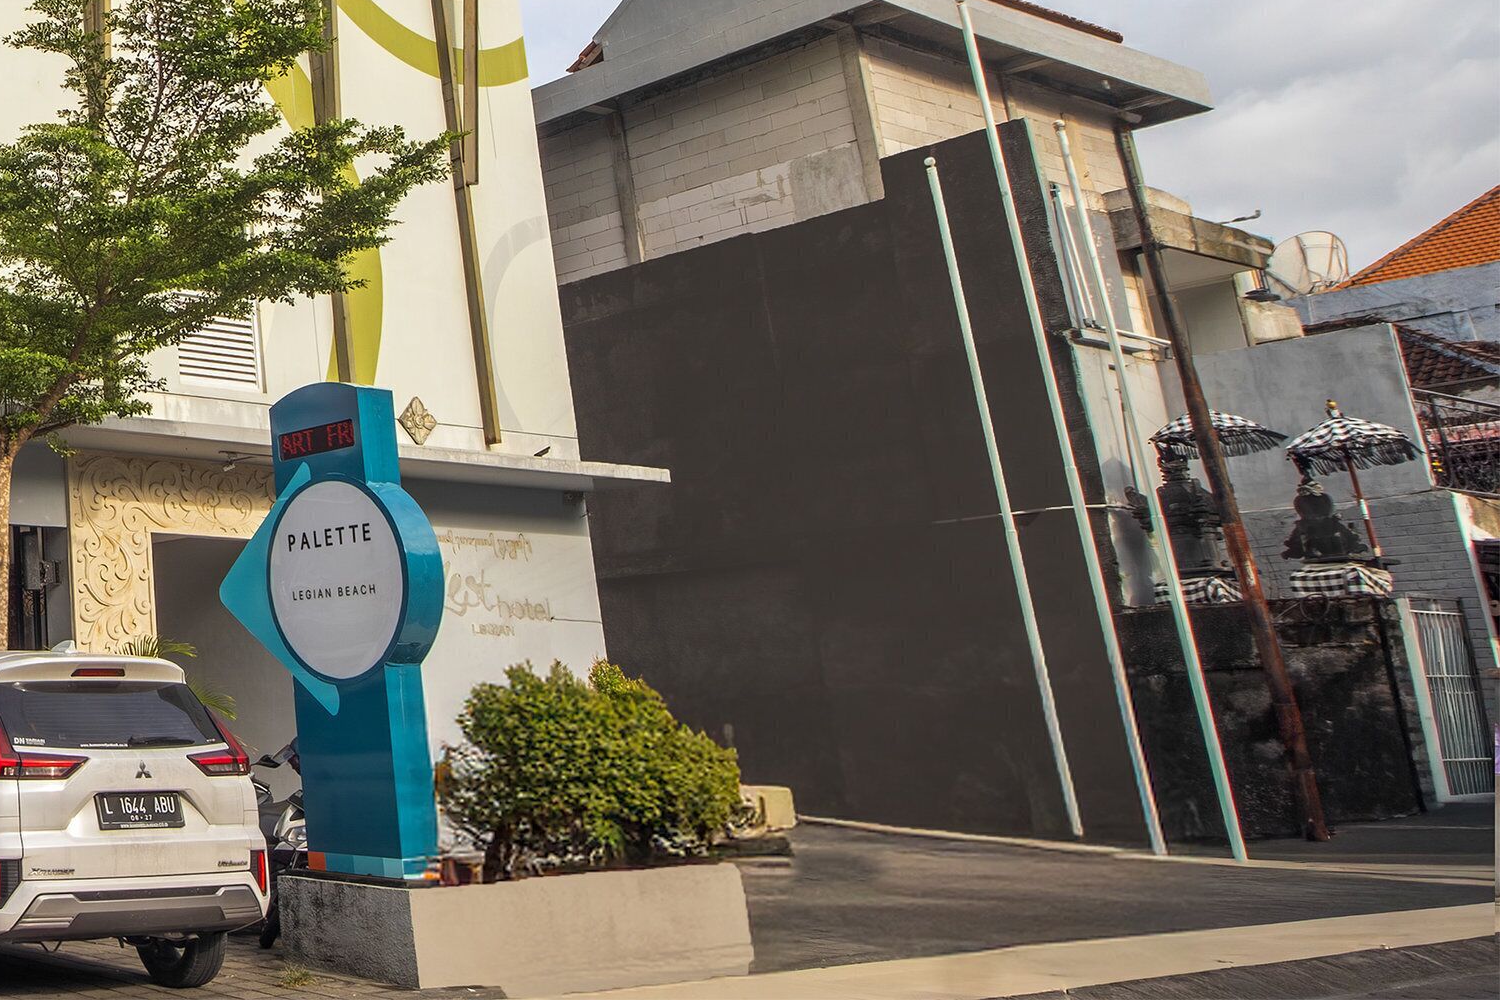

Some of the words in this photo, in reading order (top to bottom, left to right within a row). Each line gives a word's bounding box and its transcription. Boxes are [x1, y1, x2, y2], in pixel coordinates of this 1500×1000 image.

[288, 523, 371, 551] PALETTE
[292, 587, 332, 601] LEGIAN
[338, 584, 376, 598] BEACH
[103, 797, 114, 814] L
[120, 796, 147, 814] 1644
[154, 796, 175, 813] ABU
